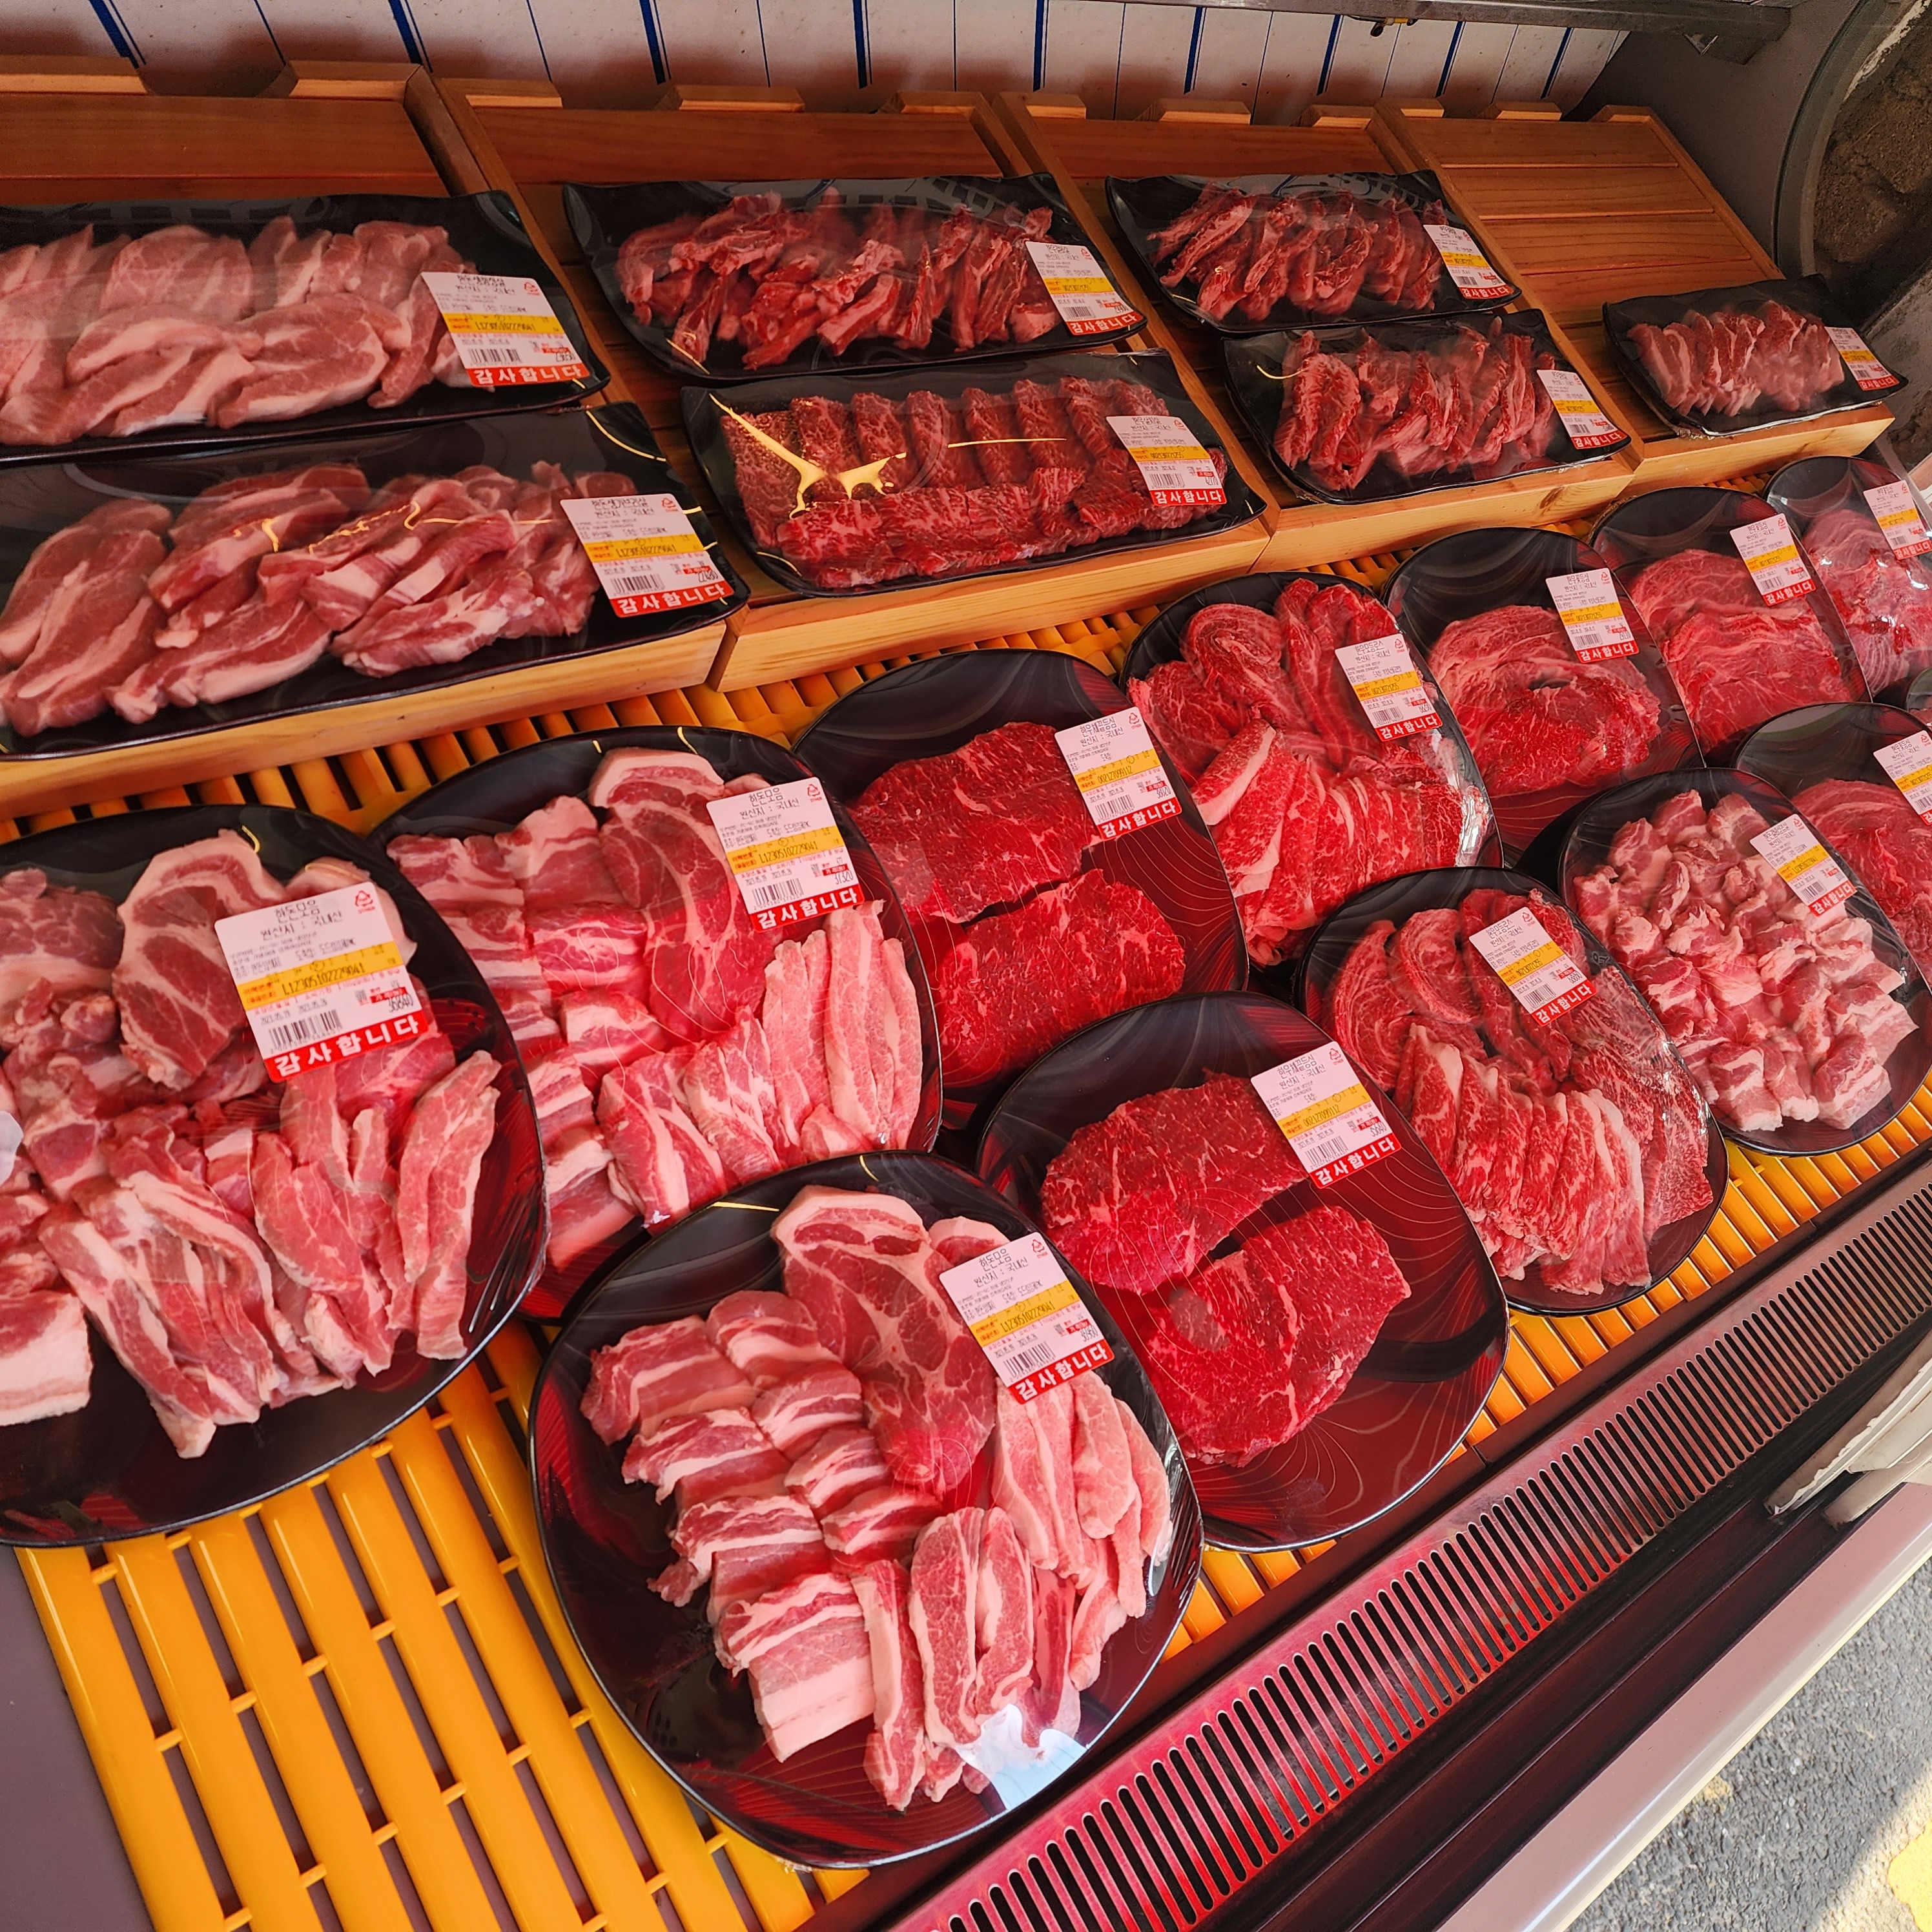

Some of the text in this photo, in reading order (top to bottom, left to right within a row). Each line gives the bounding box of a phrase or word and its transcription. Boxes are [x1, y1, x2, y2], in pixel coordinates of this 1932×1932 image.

[1462, 287, 1509, 297] 감사합니다
[1071, 314, 1137, 333] 감사합니다
[475, 365, 581, 384] 감사합니다
[1574, 433, 1622, 447] 감사합니다
[1155, 490, 1222, 504] 감사합니다
[618, 584, 725, 613] 감사합니다
[1766, 582, 1813, 604] 감사합니다
[1355, 641, 1385, 655] 한우모듬로스
[1580, 642, 1634, 661] 감사합니다
[1380, 715, 1439, 739] 감사합니다
[1097, 765, 1133, 784] 002127099112
[739, 807, 765, 820] 원산지
[776, 797, 800, 810] 국내산
[748, 787, 783, 807] 한돈모음
[1102, 801, 1176, 838] 감사합니다
[758, 841, 818, 863] L12305102229041
[832, 870, 854, 885] 37320
[757, 888, 857, 929] 감사합니다
[1812, 882, 1854, 914] 감사합니다
[275, 899, 320, 924] 한돈모음
[1486, 920, 1515, 940] 한우모듬로스
[1536, 984, 1592, 1023] 감사합니다
[274, 1015, 418, 1076] 감사합니다
[1277, 1054, 1317, 1079] 한우채끝등심
[1279, 1075, 1300, 1090] 원산지
[1305, 1064, 1326, 1077] 국내산
[1302, 1104, 1342, 1127] 002127099112
[1315, 1137, 1395, 1185] 감사합니다
[979, 1248, 1012, 1272] 한돈모음
[973, 1270, 998, 1288] 원산지
[1005, 1257, 1029, 1271] 국내산
[1000, 1300, 1056, 1333] L12305102229041
[1012, 1343, 1110, 1401] 감사합니다
